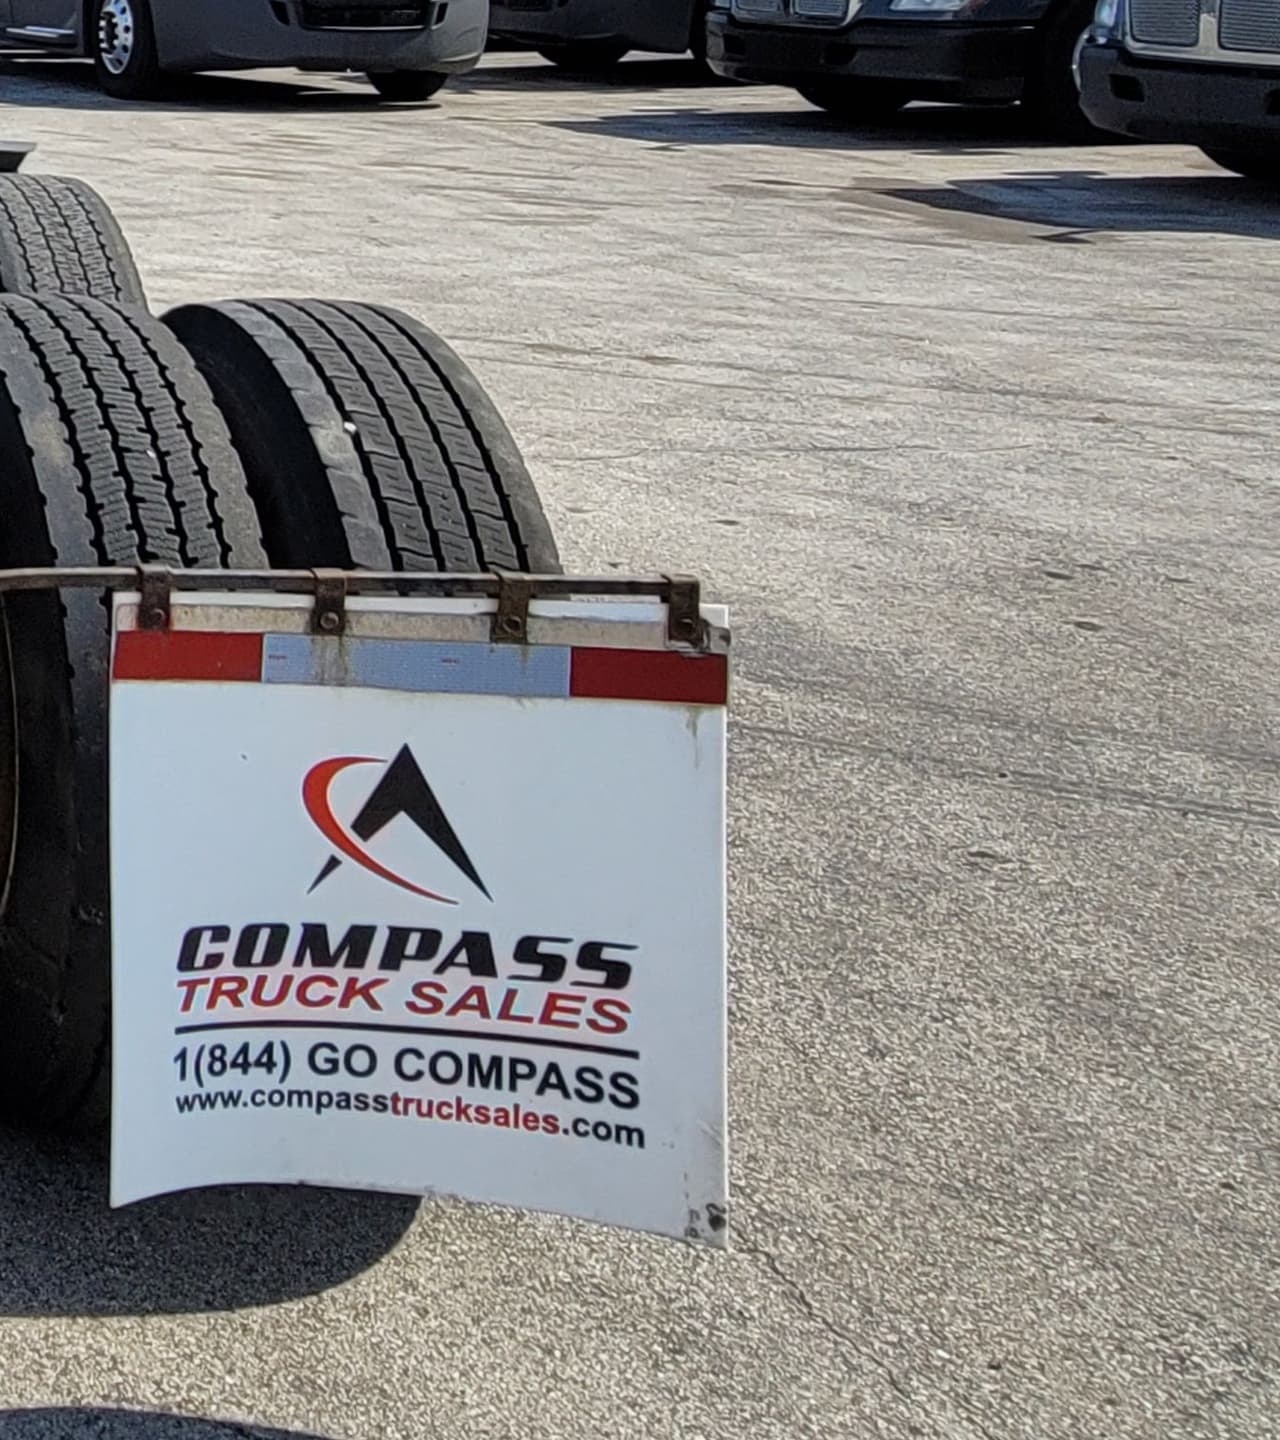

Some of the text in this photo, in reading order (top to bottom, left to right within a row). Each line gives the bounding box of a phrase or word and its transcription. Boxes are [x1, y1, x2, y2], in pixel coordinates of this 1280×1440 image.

[175, 921, 640, 991] COMPASS
[176, 974, 632, 1035] TRUCK SALES
[173, 1039, 641, 1111] 1(844) GO COMPASS
[175, 1087, 646, 1150] www.compasstrucksales.com
